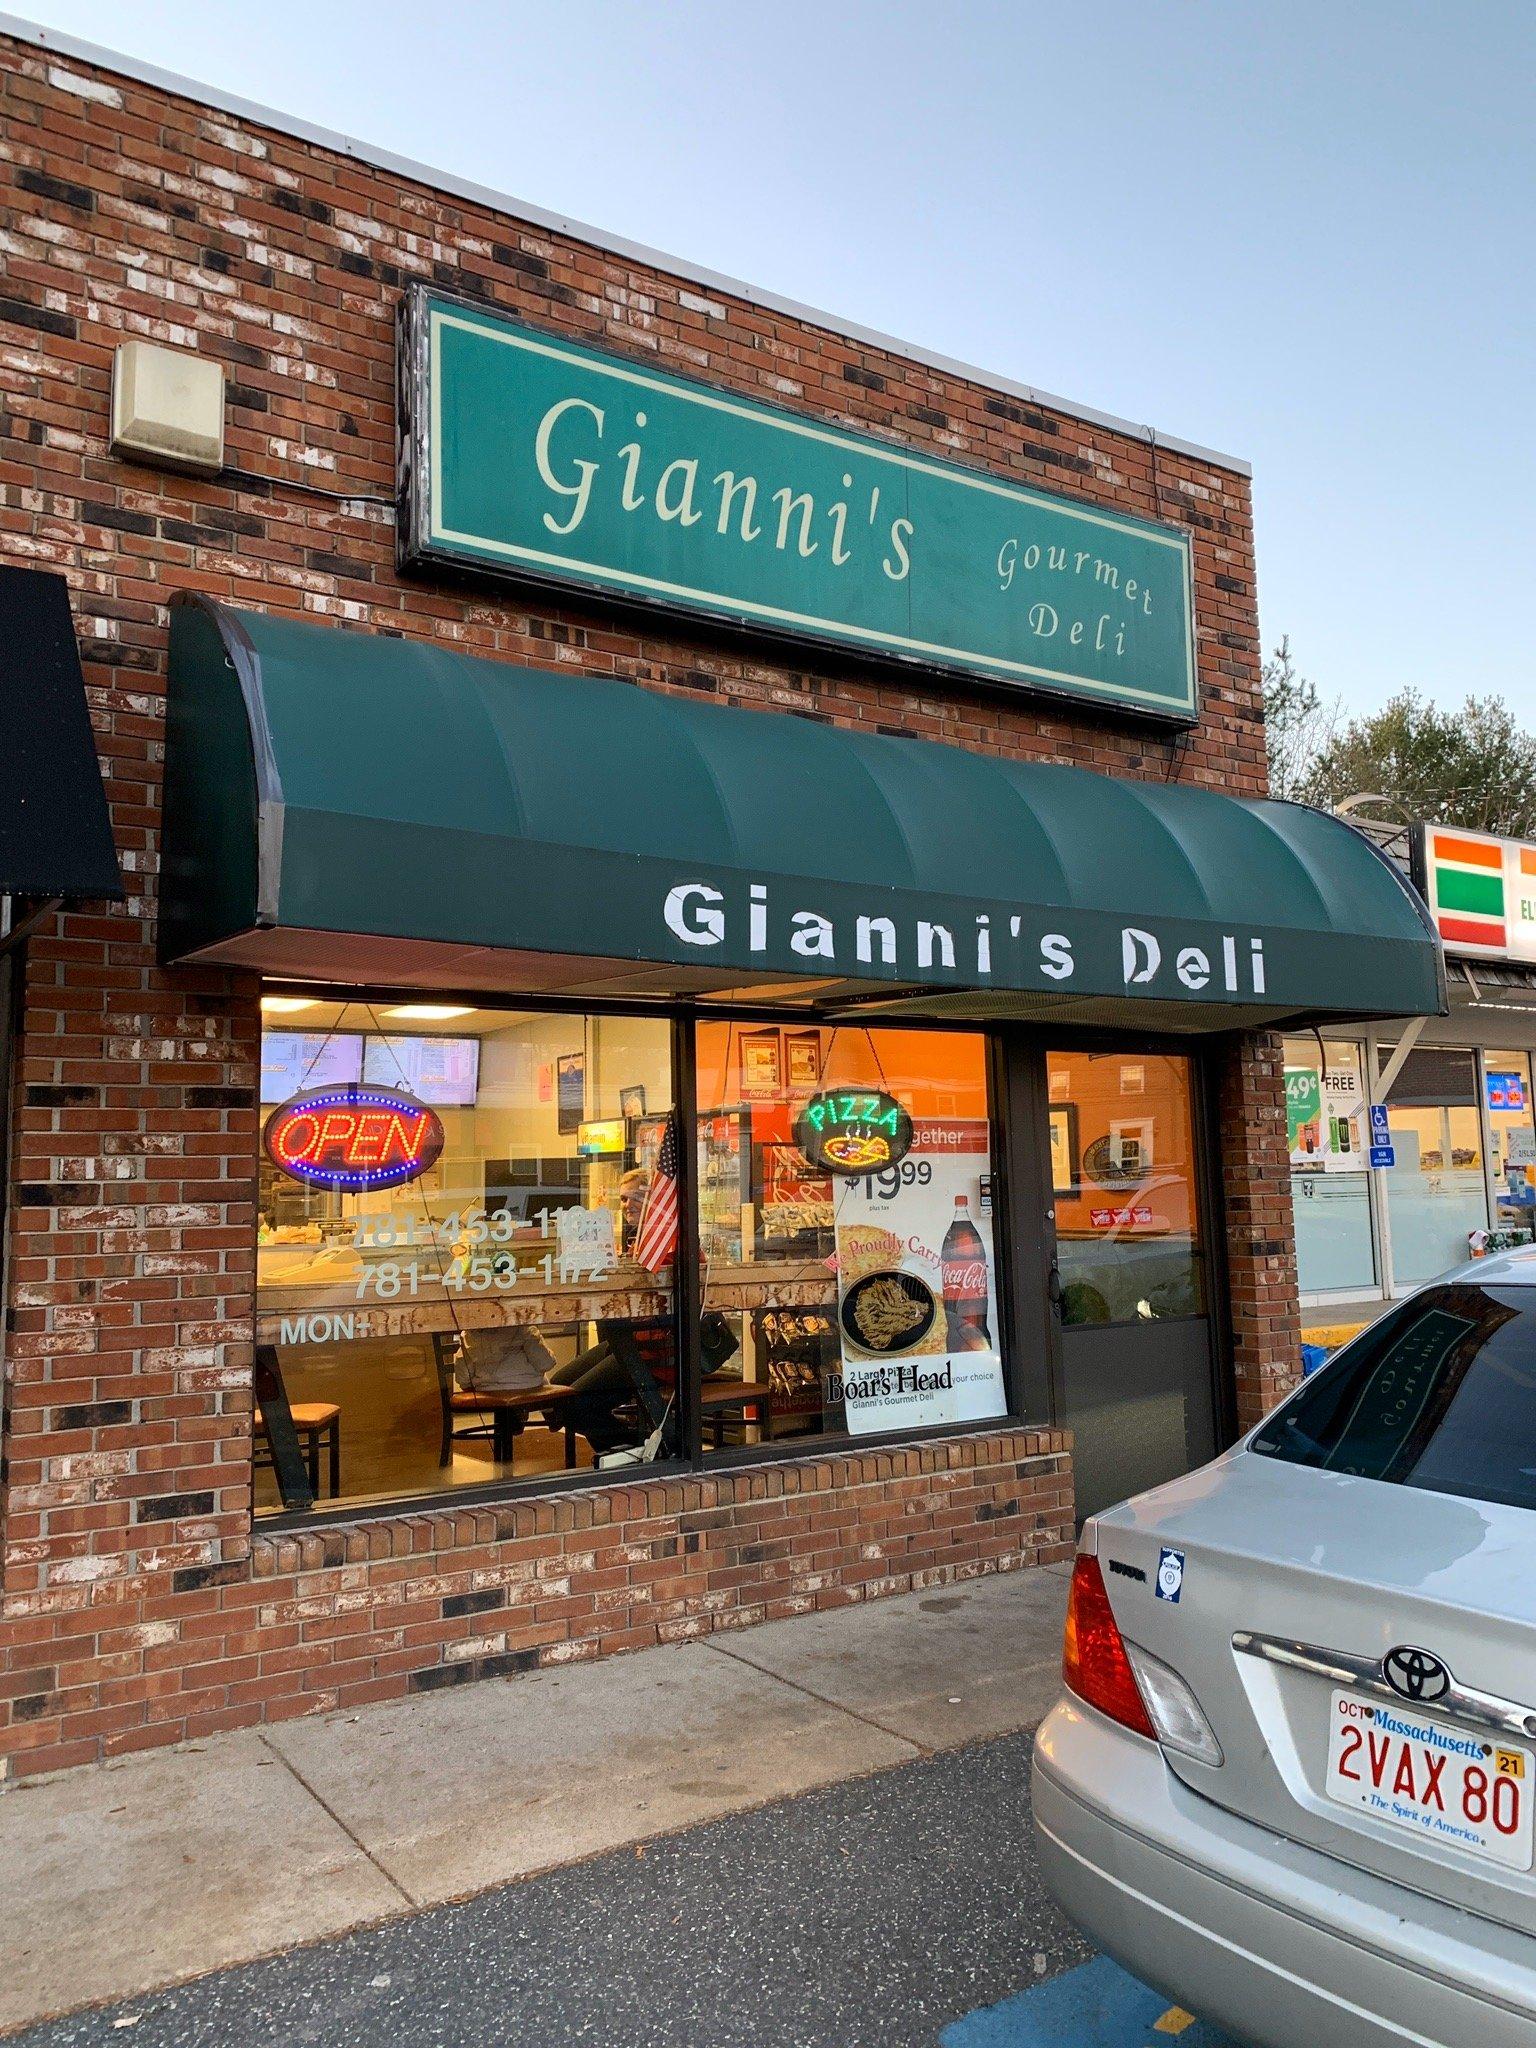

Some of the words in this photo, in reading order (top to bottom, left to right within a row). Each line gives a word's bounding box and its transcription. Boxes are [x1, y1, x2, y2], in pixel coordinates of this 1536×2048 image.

[535, 397, 914, 582] Gianni's
[997, 538, 1154, 617] Gourmet
[1028, 602, 1126, 657] Deli
[1521, 899, 1536, 921] EL
[663, 883, 1075, 980] Gianni's
[1122, 927, 1265, 994] Deli
[1325, 1077, 1354, 1091] FREE
[808, 1096, 898, 1136] PIZZA
[911, 1126, 964, 1148] gether
[276, 1112, 430, 1164] OPEN
[849, 1233, 904, 1257] Proudly
[908, 1236, 944, 1270] Carry
[826, 1366, 891, 1404] Boar's
[896, 1360, 953, 1394] Head
[850, 1371, 856, 1382] 2
[952, 1375, 968, 1385] your
[970, 1372, 994, 1382] choice
[852, 1397, 883, 1409] Gianni's
[884, 1394, 919, 1406] Gourmet
[919, 1392, 935, 1402] Deli
[1338, 1700, 1366, 1719] OCT
[1373, 1709, 1485, 1760] Massachusetts
[1338, 1725, 1447, 1812] 2VAX
[1462, 1765, 1520, 1835] 80
[1500, 1757, 1518, 1775] 21
[1370, 1793, 1389, 1809] The
[1392, 1802, 1418, 1821] Spirit
[1421, 1815, 1433, 1827] of
[1433, 1818, 1480, 1844] America
